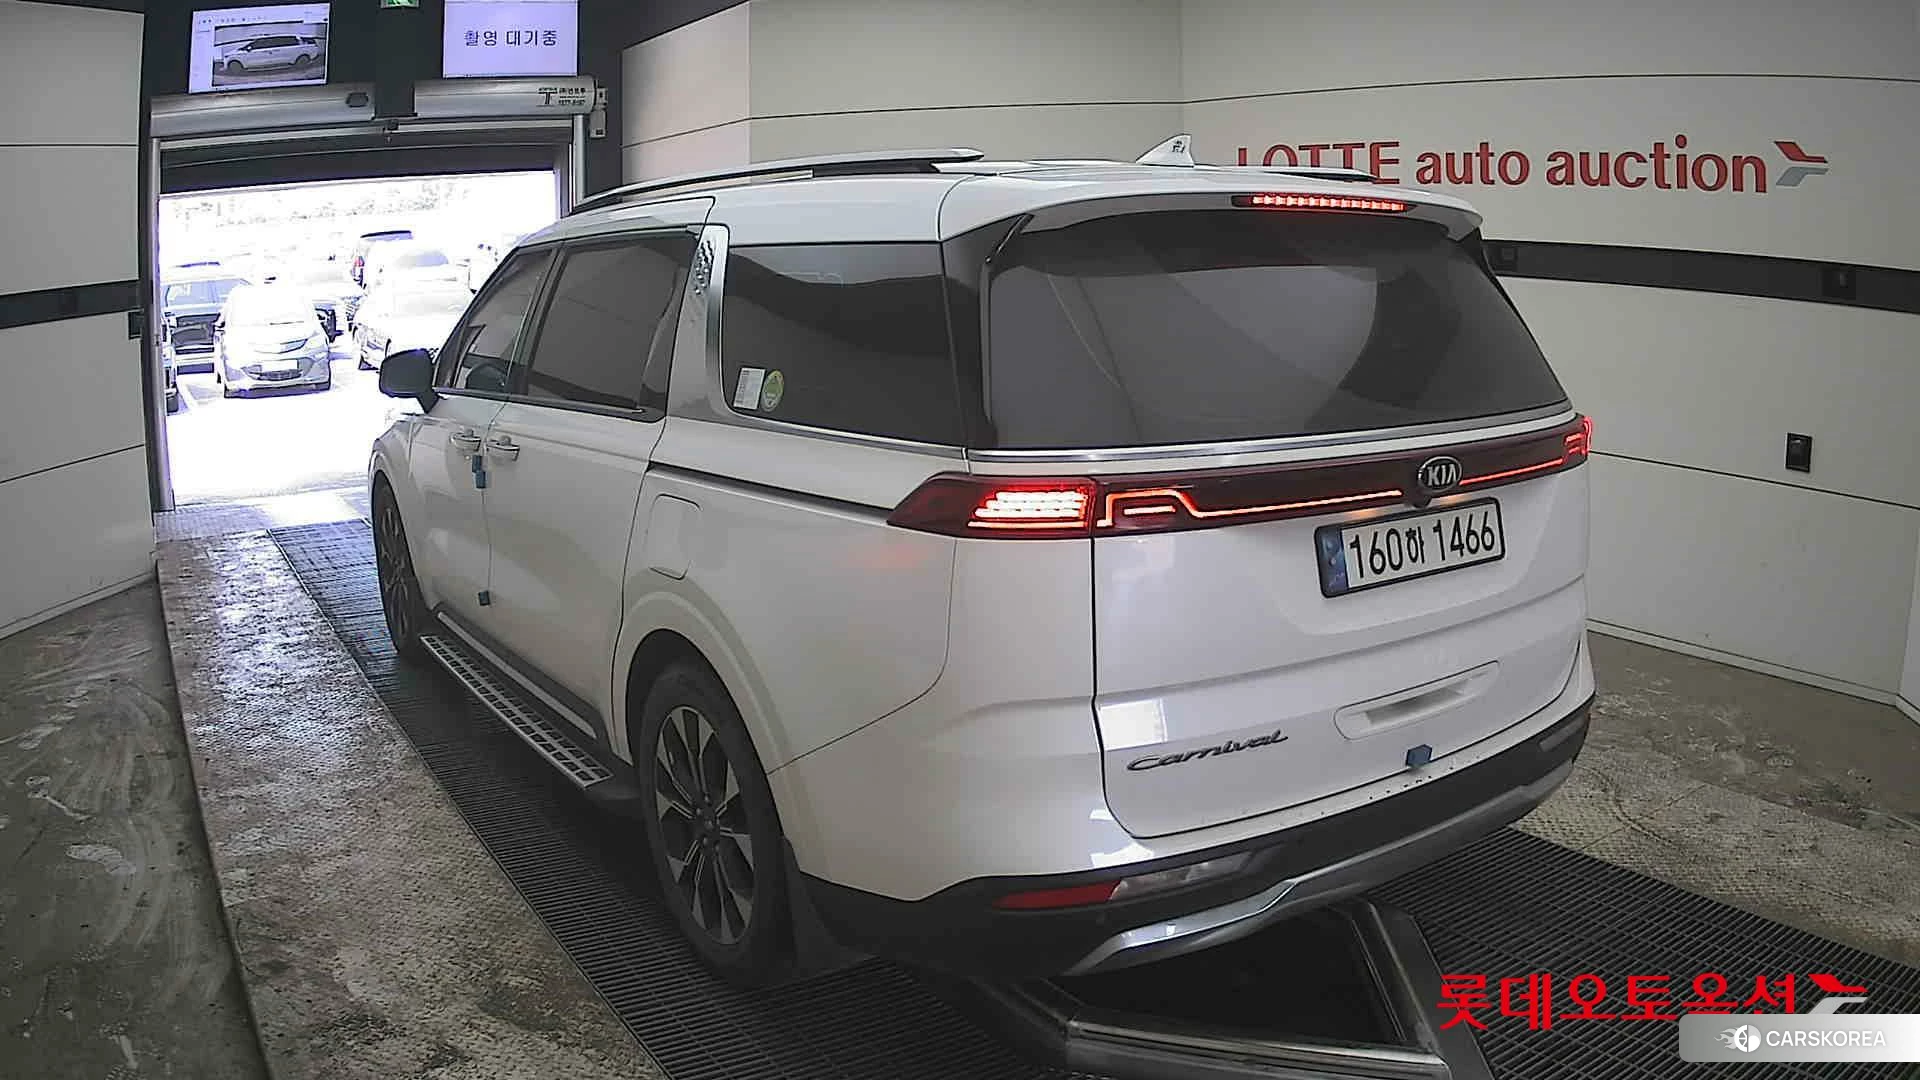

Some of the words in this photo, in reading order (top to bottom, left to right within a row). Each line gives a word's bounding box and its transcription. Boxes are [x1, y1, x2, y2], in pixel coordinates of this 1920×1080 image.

[506, 30, 557, 47] 대기중
[1415, 141, 1530, 186] auto
[1546, 134, 1767, 194] auction
[1426, 464, 1457, 487] KIA
[1350, 526, 1425, 579] 160하
[1433, 511, 1495, 561] 1466
[1127, 730, 1288, 771] Carnival
